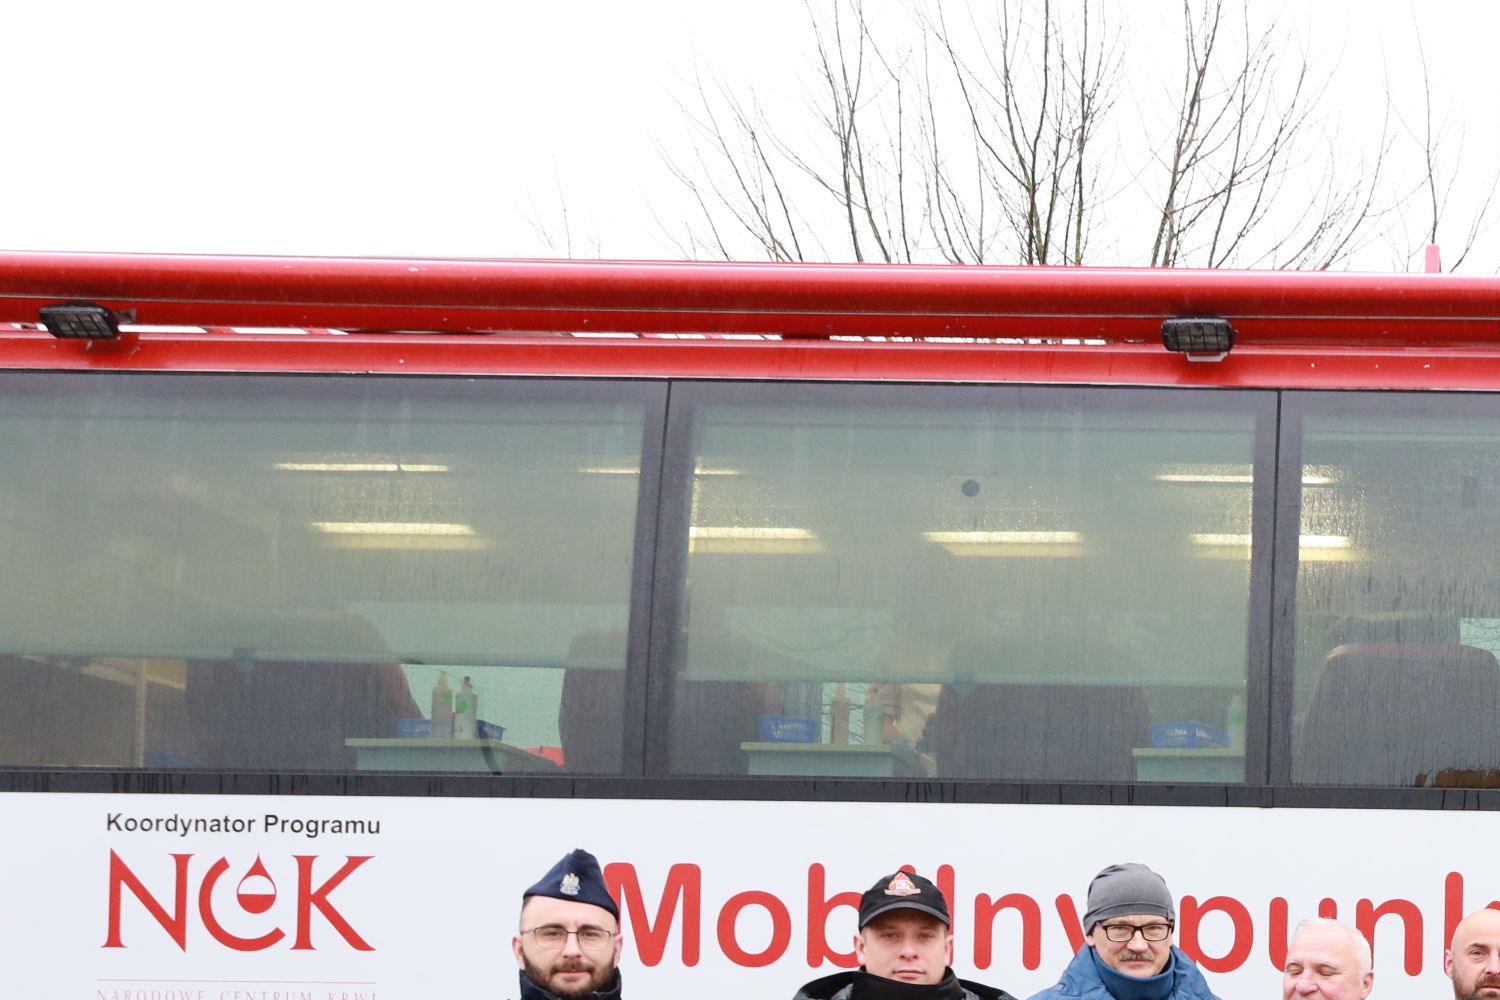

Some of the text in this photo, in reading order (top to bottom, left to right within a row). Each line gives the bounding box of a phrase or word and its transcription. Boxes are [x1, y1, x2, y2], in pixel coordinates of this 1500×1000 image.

[106, 813, 381, 838] Koordynator Programu
[100, 848, 376, 953] NCK
